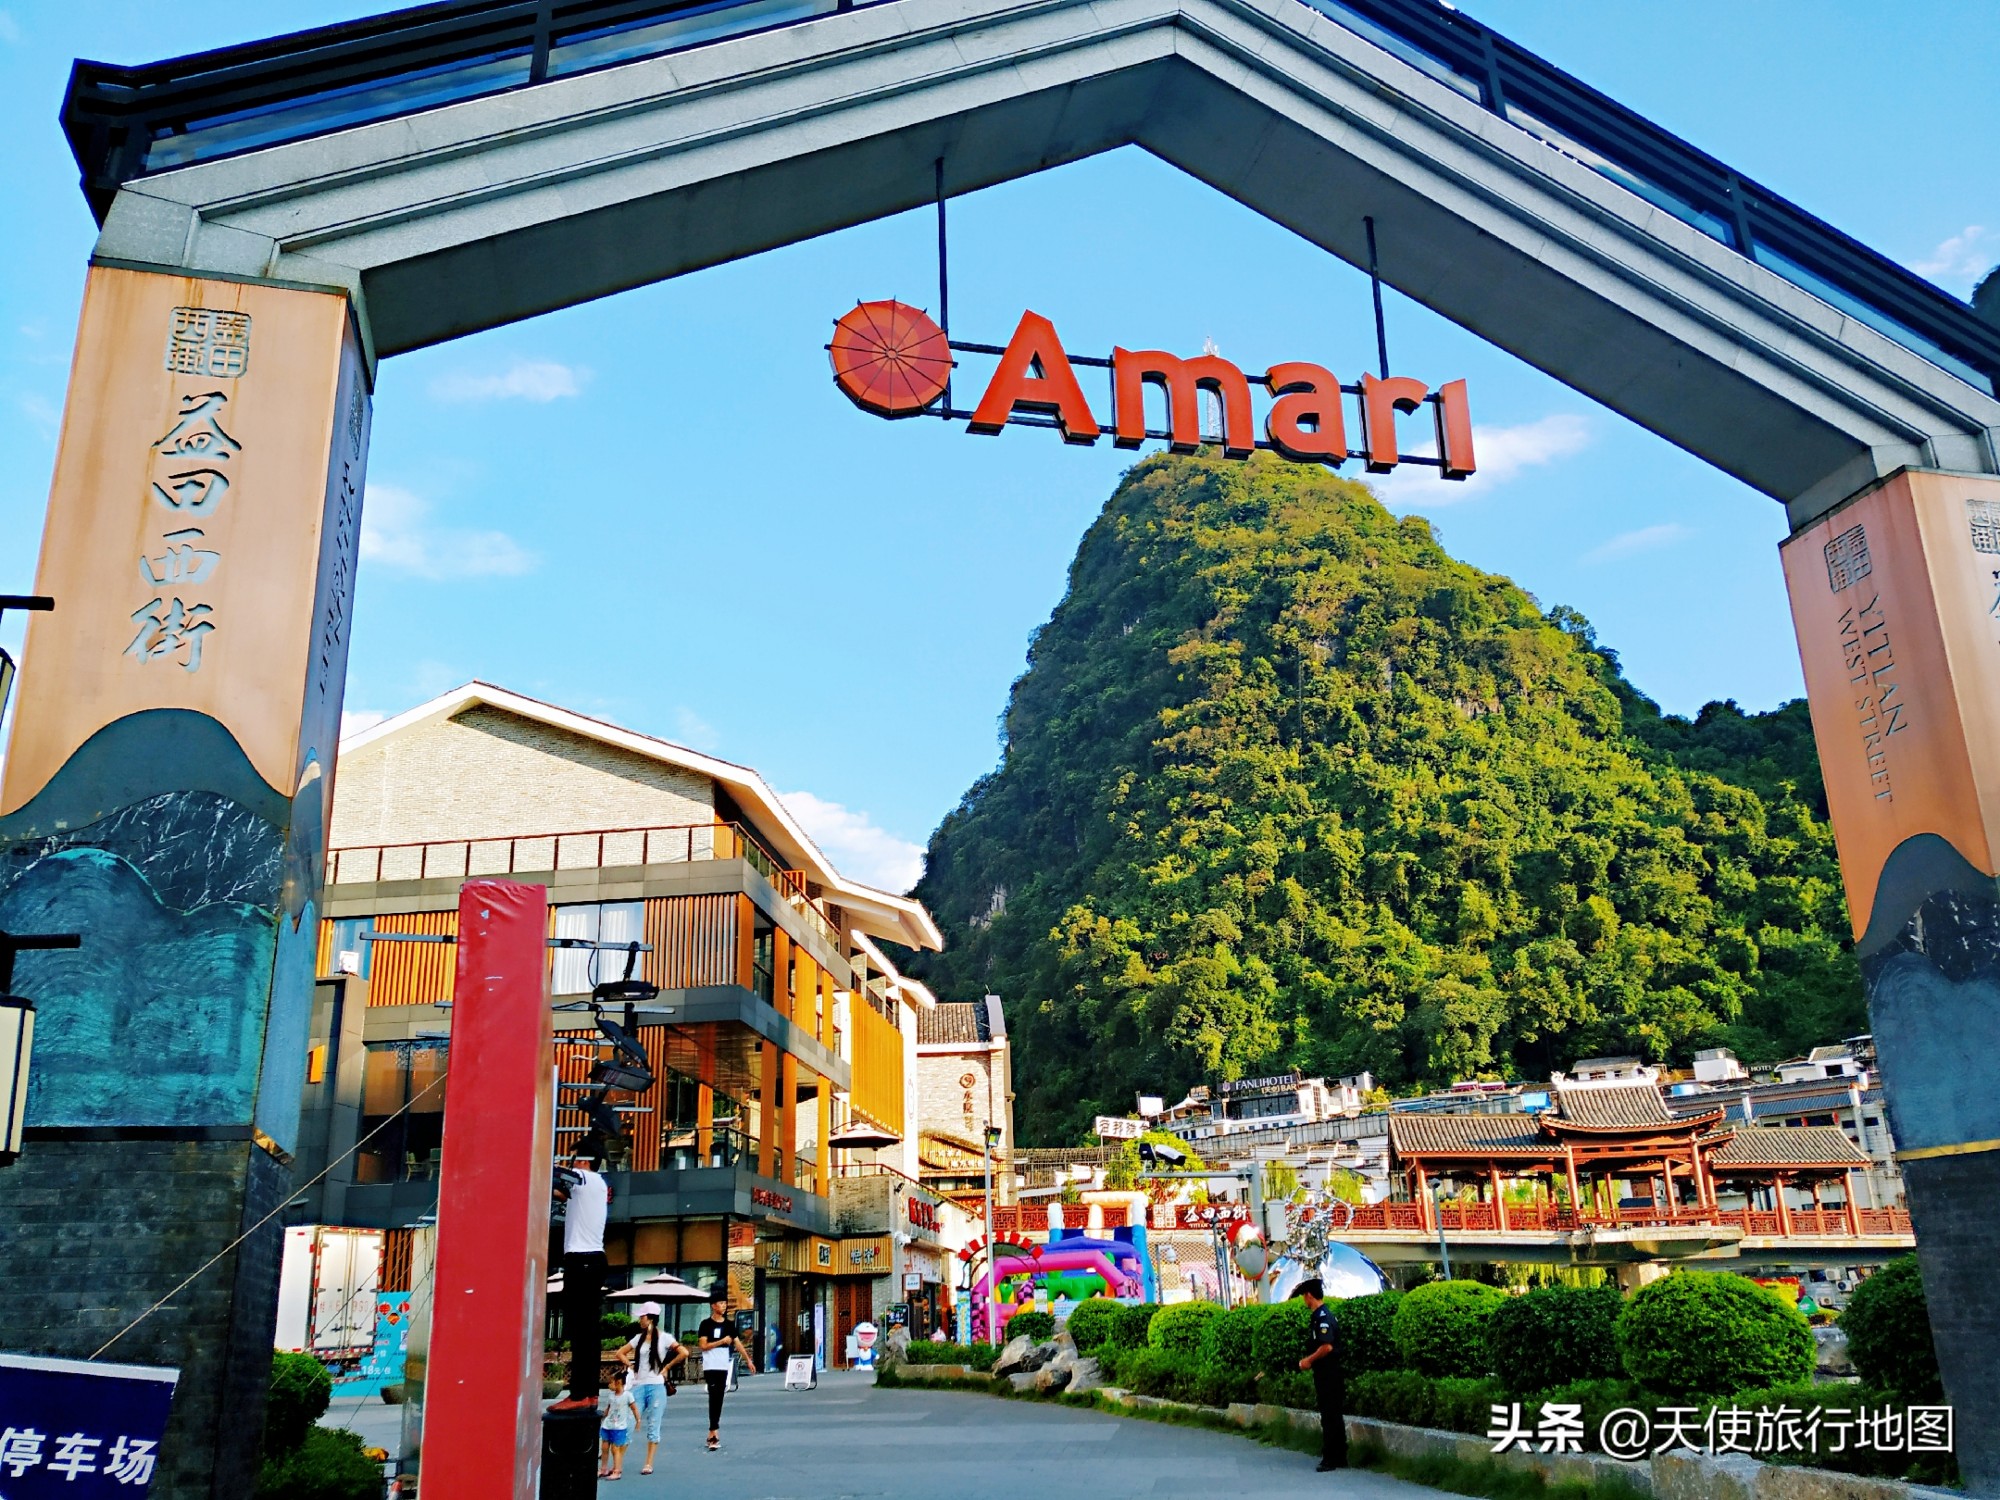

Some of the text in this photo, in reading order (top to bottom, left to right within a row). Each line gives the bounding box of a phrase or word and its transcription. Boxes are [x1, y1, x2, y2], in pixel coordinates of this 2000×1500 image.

[966, 309, 1477, 481] Amari
[123, 391, 242, 673] 益田西街
[1837, 607, 1893, 804] WEST STREET
[1859, 592, 1908, 738] YITIAN
[1184, 1205, 1248, 1223] 益田西街
[0, 1426, 158, 1486] 停车场
